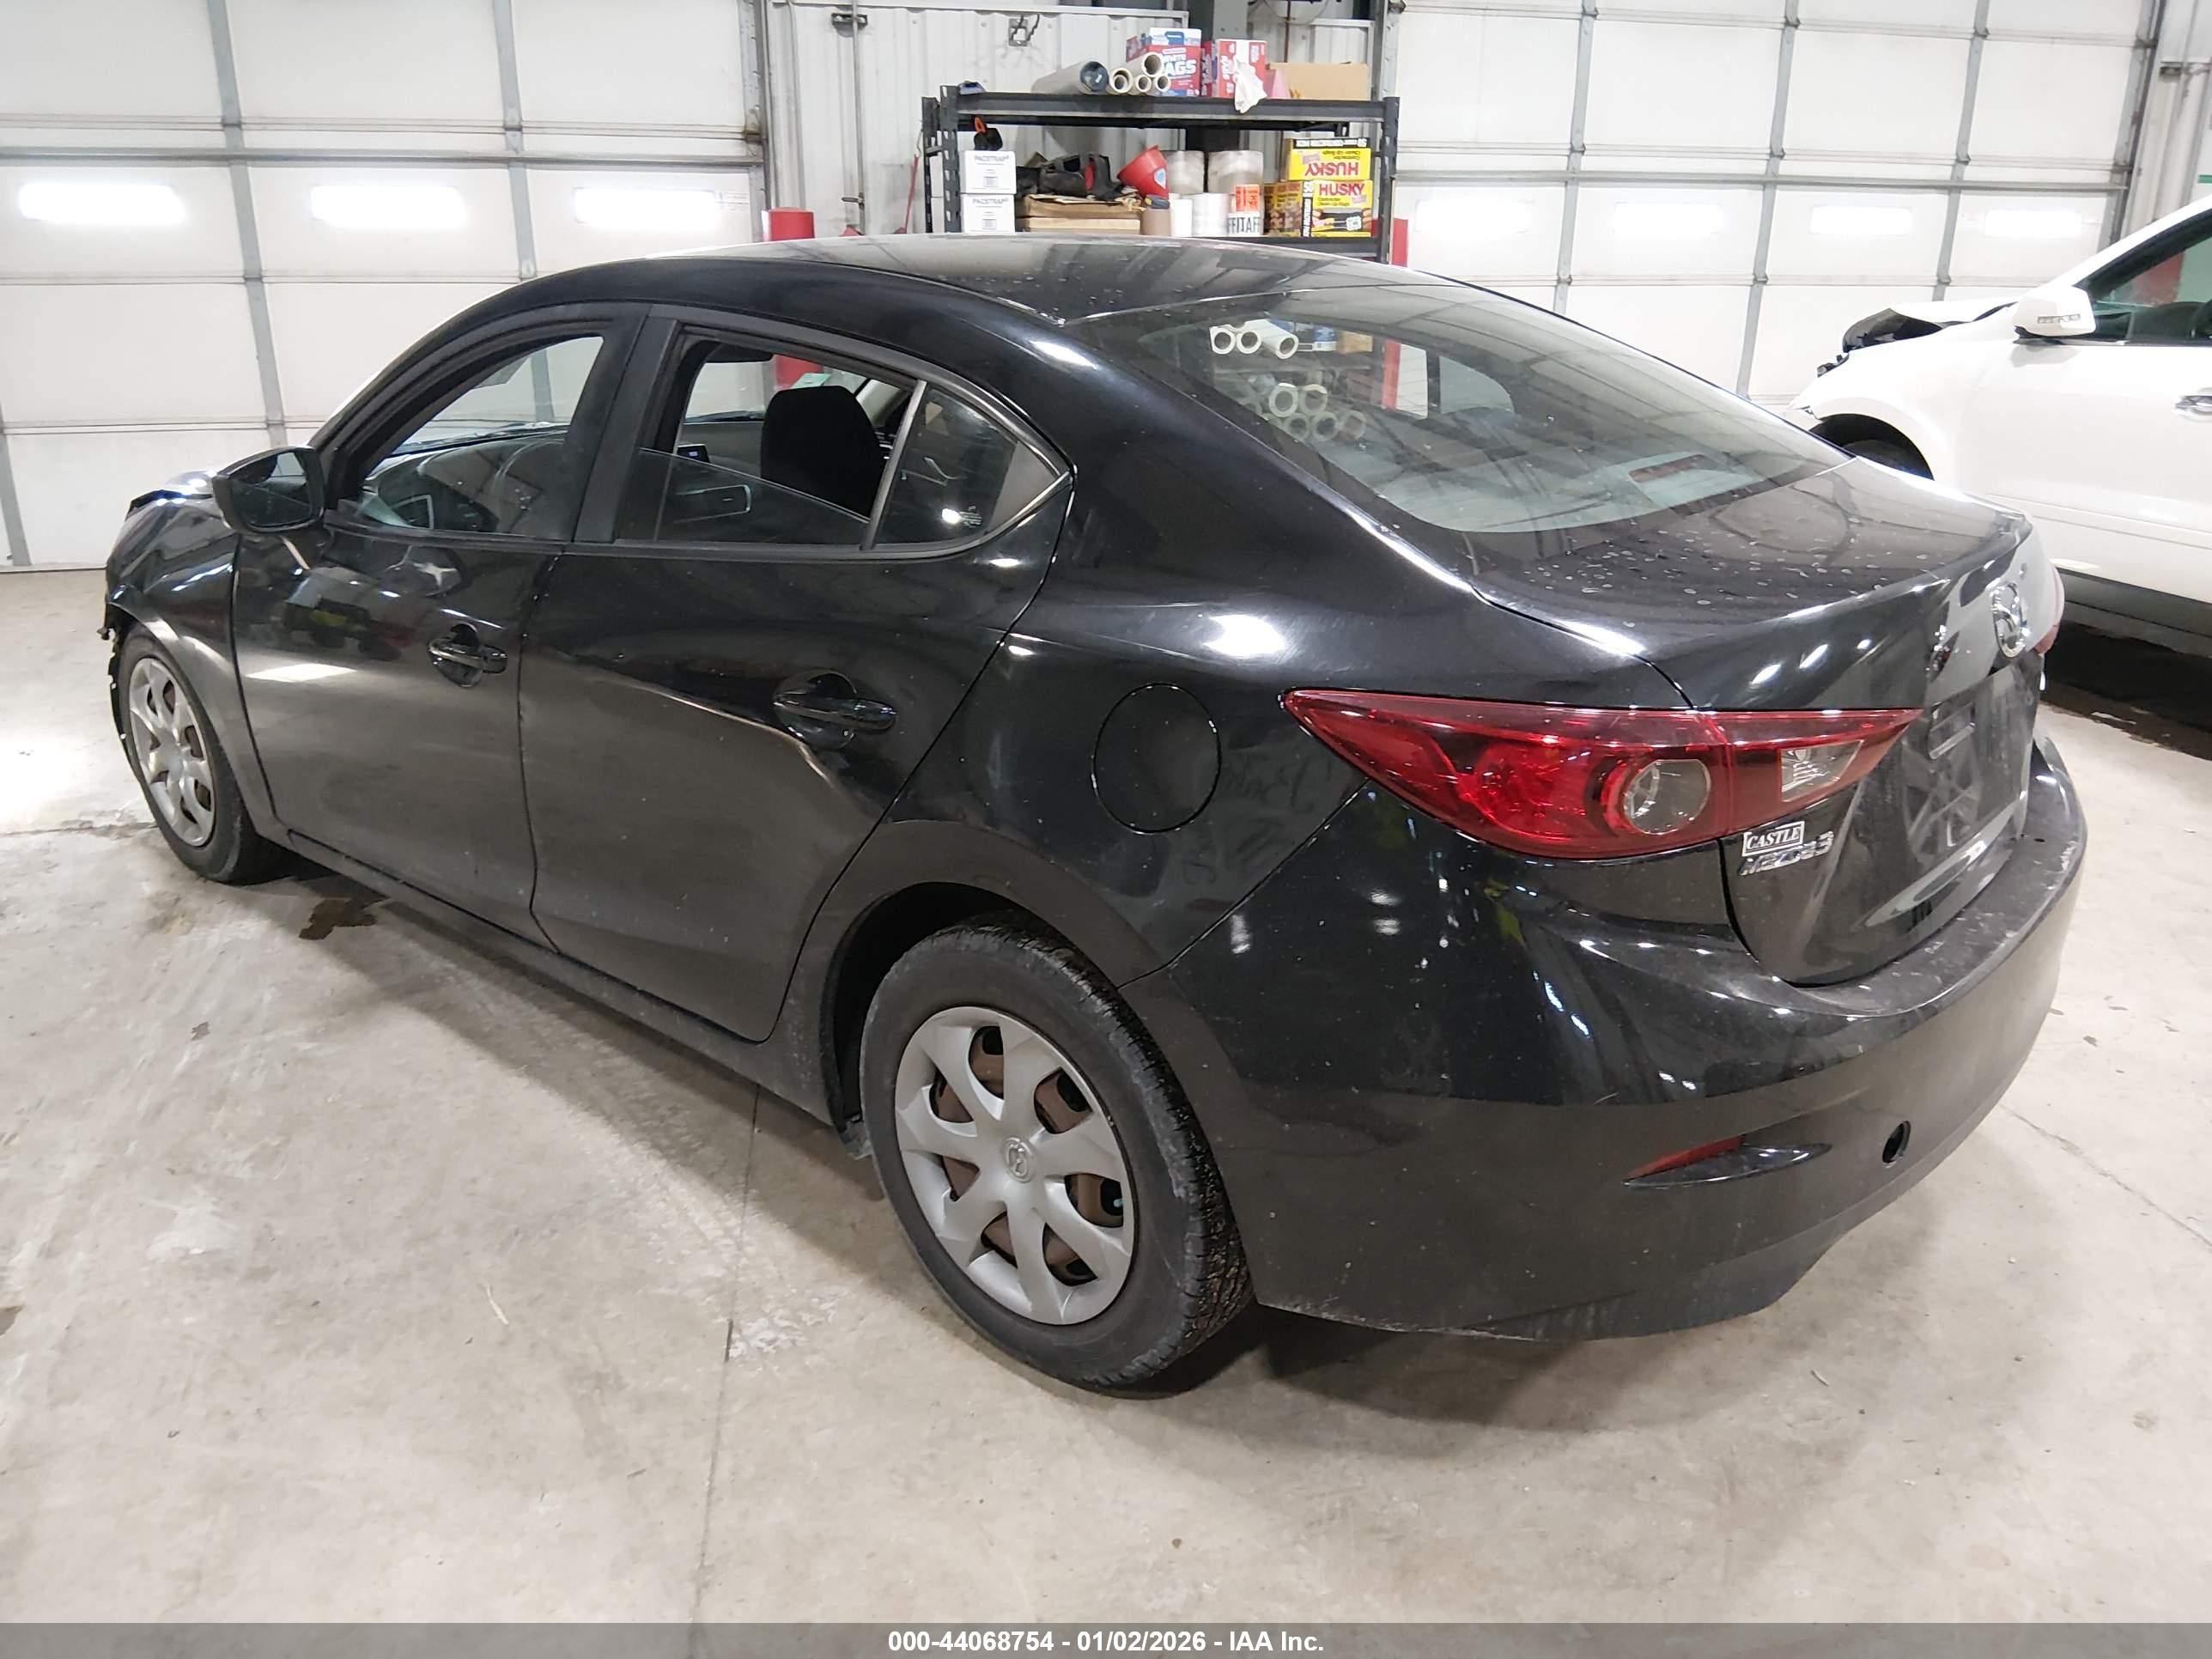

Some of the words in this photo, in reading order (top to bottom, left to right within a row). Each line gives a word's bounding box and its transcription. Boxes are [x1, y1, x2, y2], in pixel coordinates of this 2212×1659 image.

[1304, 161, 1359, 177] HUSKY
[1318, 182, 1365, 197] HUSKY
[1747, 827, 1801, 849] CASTLE
